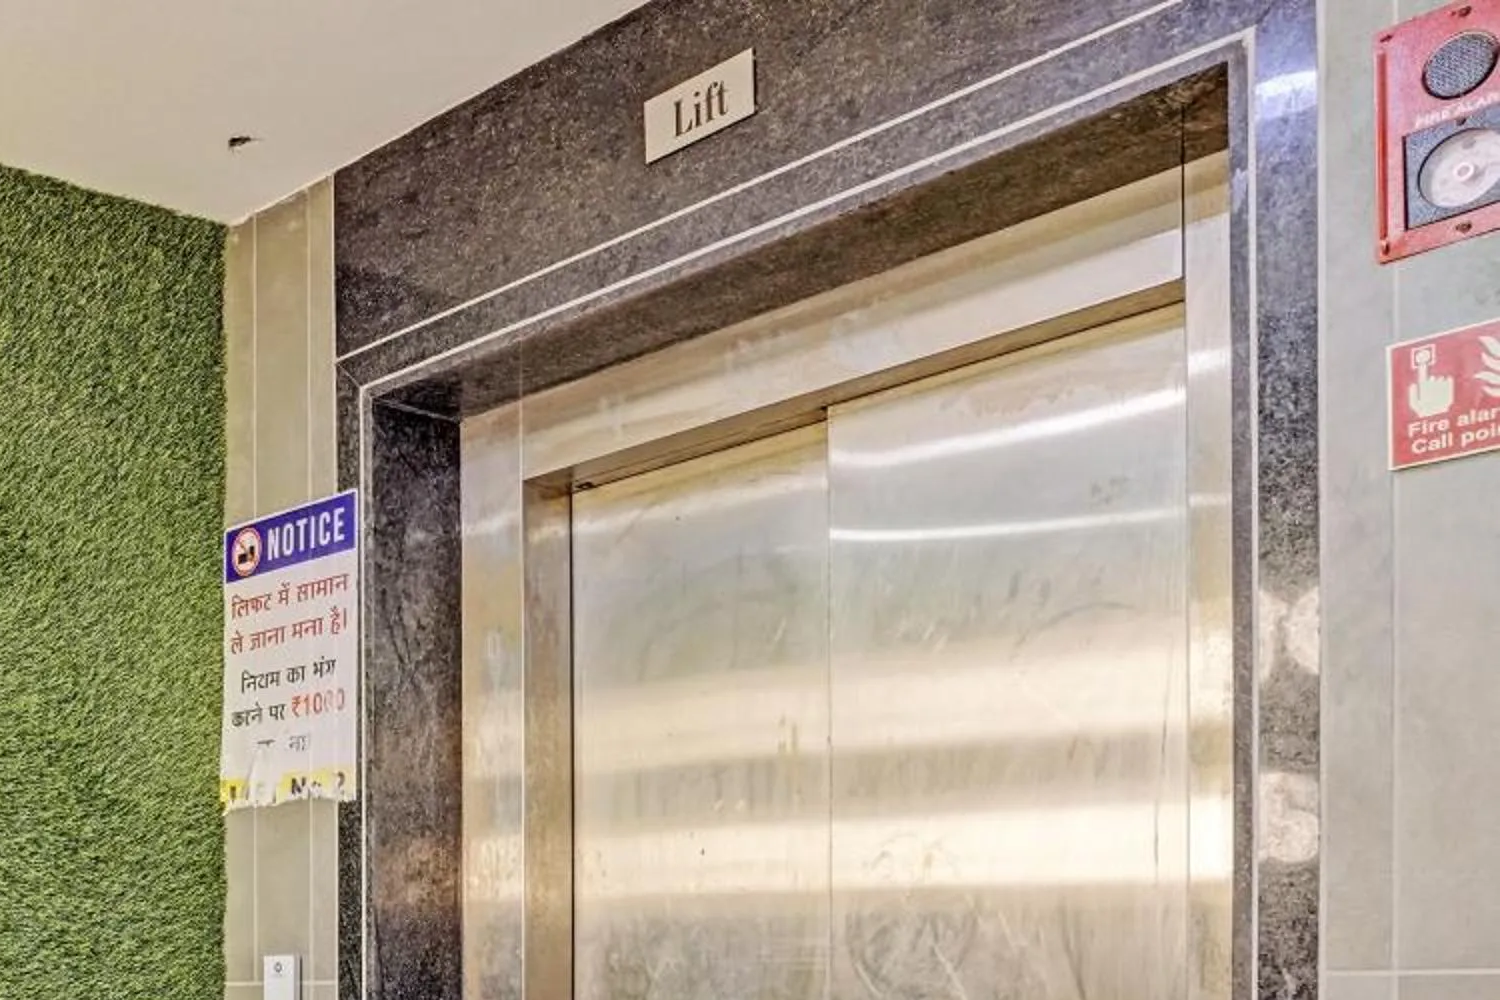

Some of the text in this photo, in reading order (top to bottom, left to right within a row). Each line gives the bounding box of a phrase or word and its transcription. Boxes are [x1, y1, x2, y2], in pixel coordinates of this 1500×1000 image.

[673, 79, 729, 137] Lift
[1408, 418, 1450, 438] Fire
[1411, 432, 1454, 454] Call
[266, 506, 346, 561] NOTICE
[277, 580, 290, 606] में
[296, 573, 349, 603] सामान
[231, 630, 244, 655] ले
[249, 624, 286, 651] जाना
[291, 616, 324, 639] मना
[241, 655, 336, 694] नियम का भंग
[231, 701, 263, 728] करने
[269, 703, 286, 721] पर
